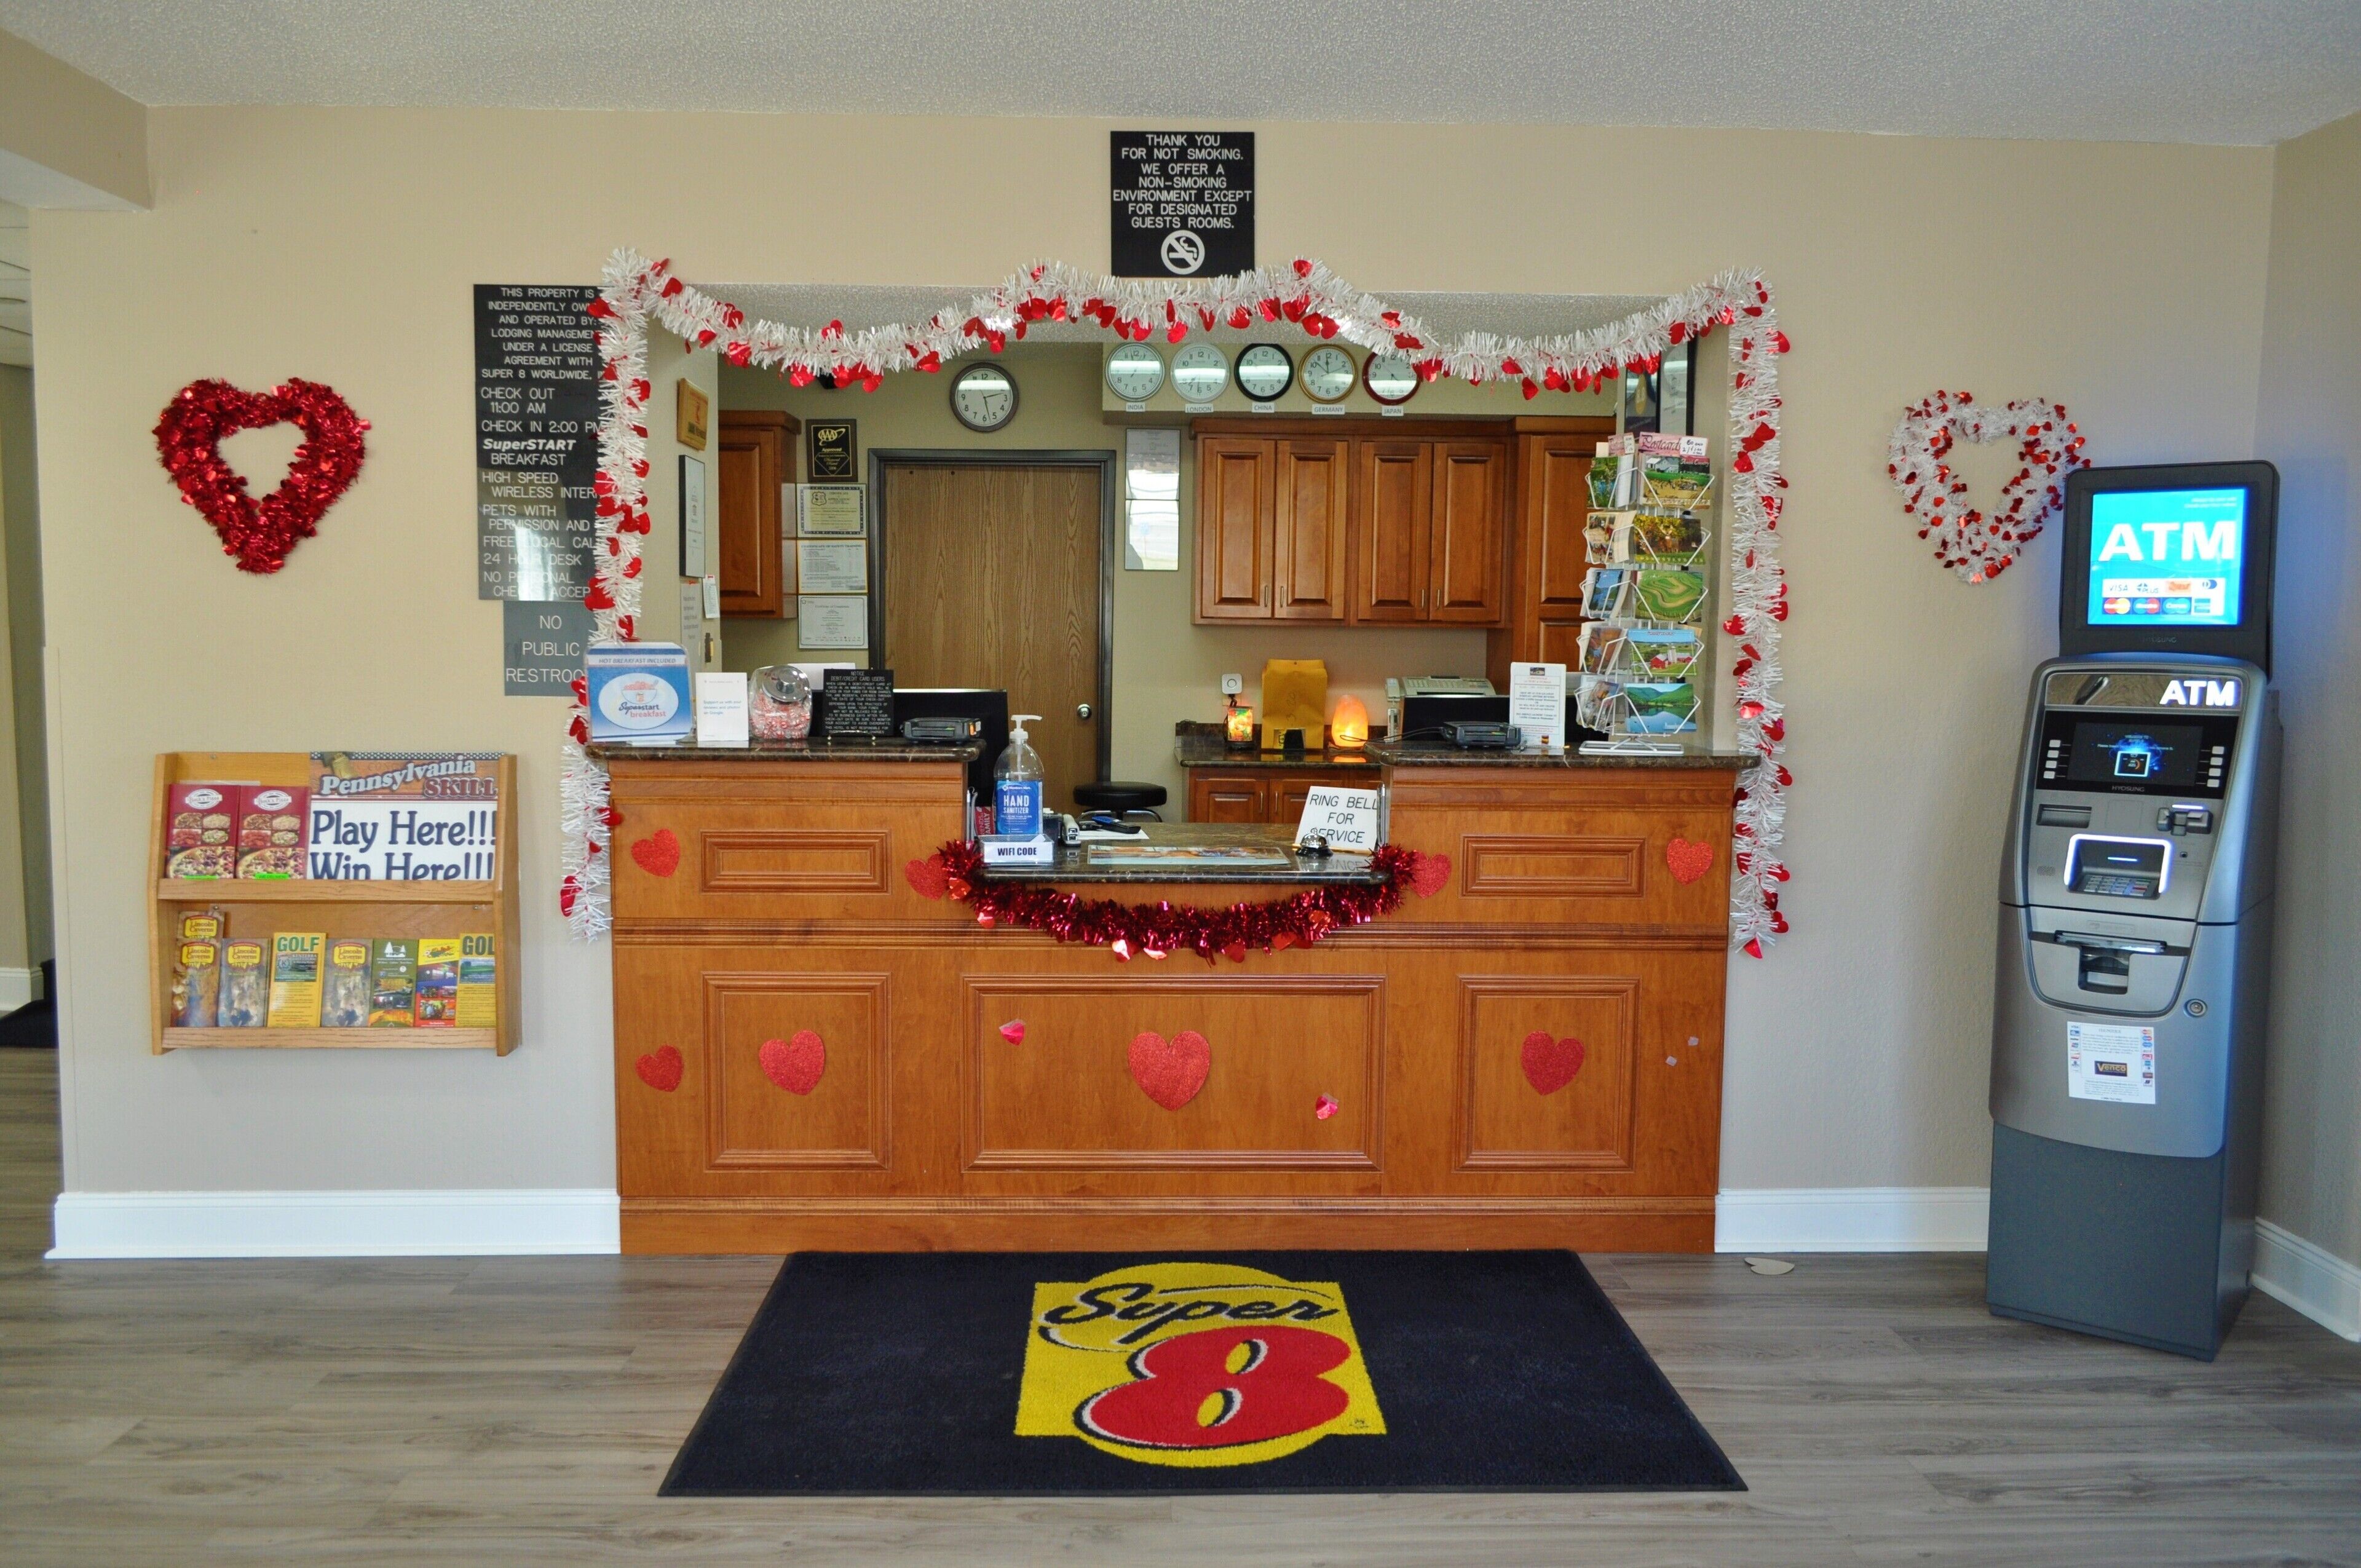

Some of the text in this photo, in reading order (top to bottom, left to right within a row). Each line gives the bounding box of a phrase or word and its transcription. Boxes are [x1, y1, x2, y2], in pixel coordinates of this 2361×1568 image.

[1146, 135, 1220, 146] THANK YOU
[1121, 148, 1243, 160] FOR NOT SMOKING.
[1141, 163, 1225, 175] WE OFFER A
[1139, 176, 1227, 188] NON-SMOKING
[1113, 190, 1252, 202] ENVIRONMENT EXCEPT
[1128, 204, 1237, 215] FOR DESIGNATED
[1131, 217, 1235, 229] GUESTS ROOMS.
[500, 287, 595, 298] THIS PROPERTY IS
[488, 301, 589, 311] INDEPENDENTLY OW
[499, 315, 598, 326] AND OPERATED BY:
[492, 328, 532, 338] LODGING
[503, 343, 593, 352] UNDER A LICENSE
[504, 355, 593, 365] AGREEMENT WITH
[481, 369, 513, 378] SUPER
[518, 370, 526, 378] 8
[481, 387, 555, 400] CHECK OUT
[491, 402, 546, 414] 11:00 AM
[481, 419, 603, 434] CHECK IN 2:00 PM
[818, 429, 838, 441] AAA
[483, 438, 577, 451] SuperSTART
[1642, 435, 1681, 451] Postcards
[491, 453, 566, 465] BREAKFAST
[482, 472, 558, 484] HIGH SPEED
[491, 486, 597, 499] WIRELESS INTER
[483, 504, 556, 517] PETS WITH
[489, 519, 590, 531] PERMISSION AND
[483, 536, 515, 547] FREE
[528, 536, 565, 548] OCAL
[2098, 521, 2237, 561] ATM
[483, 553, 500, 564] 24
[550, 554, 582, 565] DESK
[483, 571, 575, 584] NO PONAL
[539, 615, 562, 629] NO
[523, 641, 580, 656] PUBLIC
[2159, 679, 2235, 707] ATM
[320, 755, 476, 796] Pennsylvania
[424, 777, 498, 798] SKILL
[1003, 795, 1029, 807] HAND
[1310, 794, 1377, 810] RING BELL
[1327, 812, 1355, 825] FOR
[310, 809, 496, 853] Play Here!!!
[997, 847, 1037, 856] WIFI CODE
[309, 852, 371, 879] Win
[277, 936, 320, 952] GOLF
[462, 936, 494, 955] GOL
[2097, 1063, 2126, 1072] Venco
[1039, 1282, 1340, 1346] Super
[1072, 1324, 1352, 1451] 8
